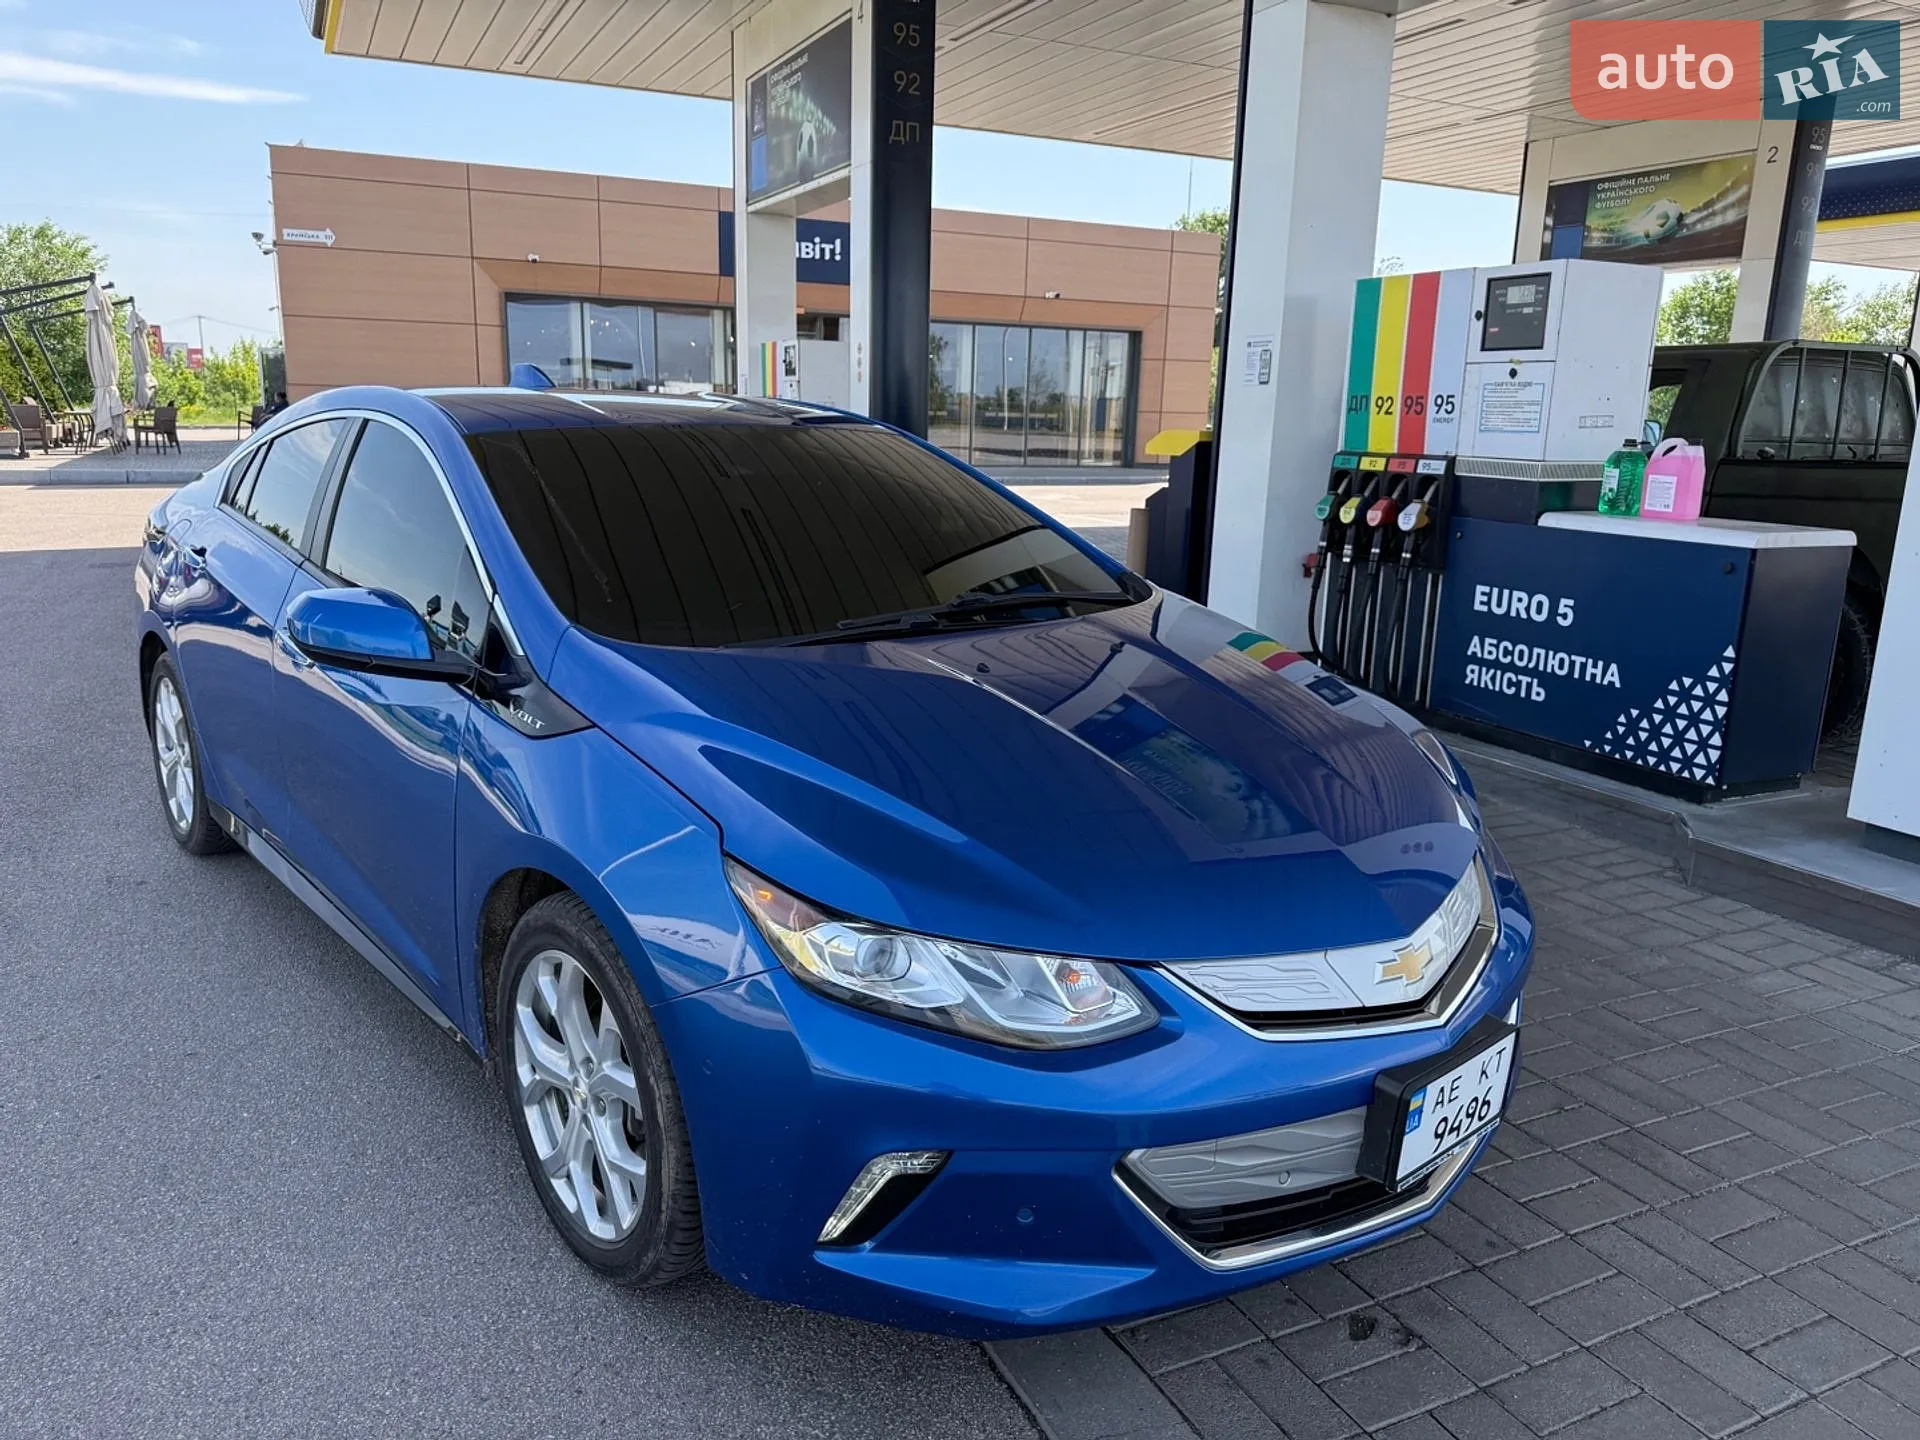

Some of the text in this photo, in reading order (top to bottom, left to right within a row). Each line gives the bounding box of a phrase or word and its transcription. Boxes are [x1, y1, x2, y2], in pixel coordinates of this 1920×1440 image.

[893, 22, 920, 47] 95
[893, 70, 920, 95] 92
[888, 119, 920, 145] ДП
[1766, 145, 1779, 164] 2
[1637, 173, 1671, 185] ПАЛЬНЕ
[1595, 185, 1656, 200] УКРАЇНСЬКОГО
[1348, 394, 1369, 415] ДП
[1375, 396, 1395, 416] 92
[1404, 395, 1425, 416] 95
[1434, 394, 1456, 415] 95
[1473, 584, 1575, 627] EURO 5
[1466, 635, 1622, 689] АБСОЛЮТНА
[1464, 663, 1546, 702] ЯКІСТЬ
[509, 700, 545, 730] VOLT
[1432, 1047, 1507, 1115] AE KT
[1433, 1085, 1494, 1155] 9496
